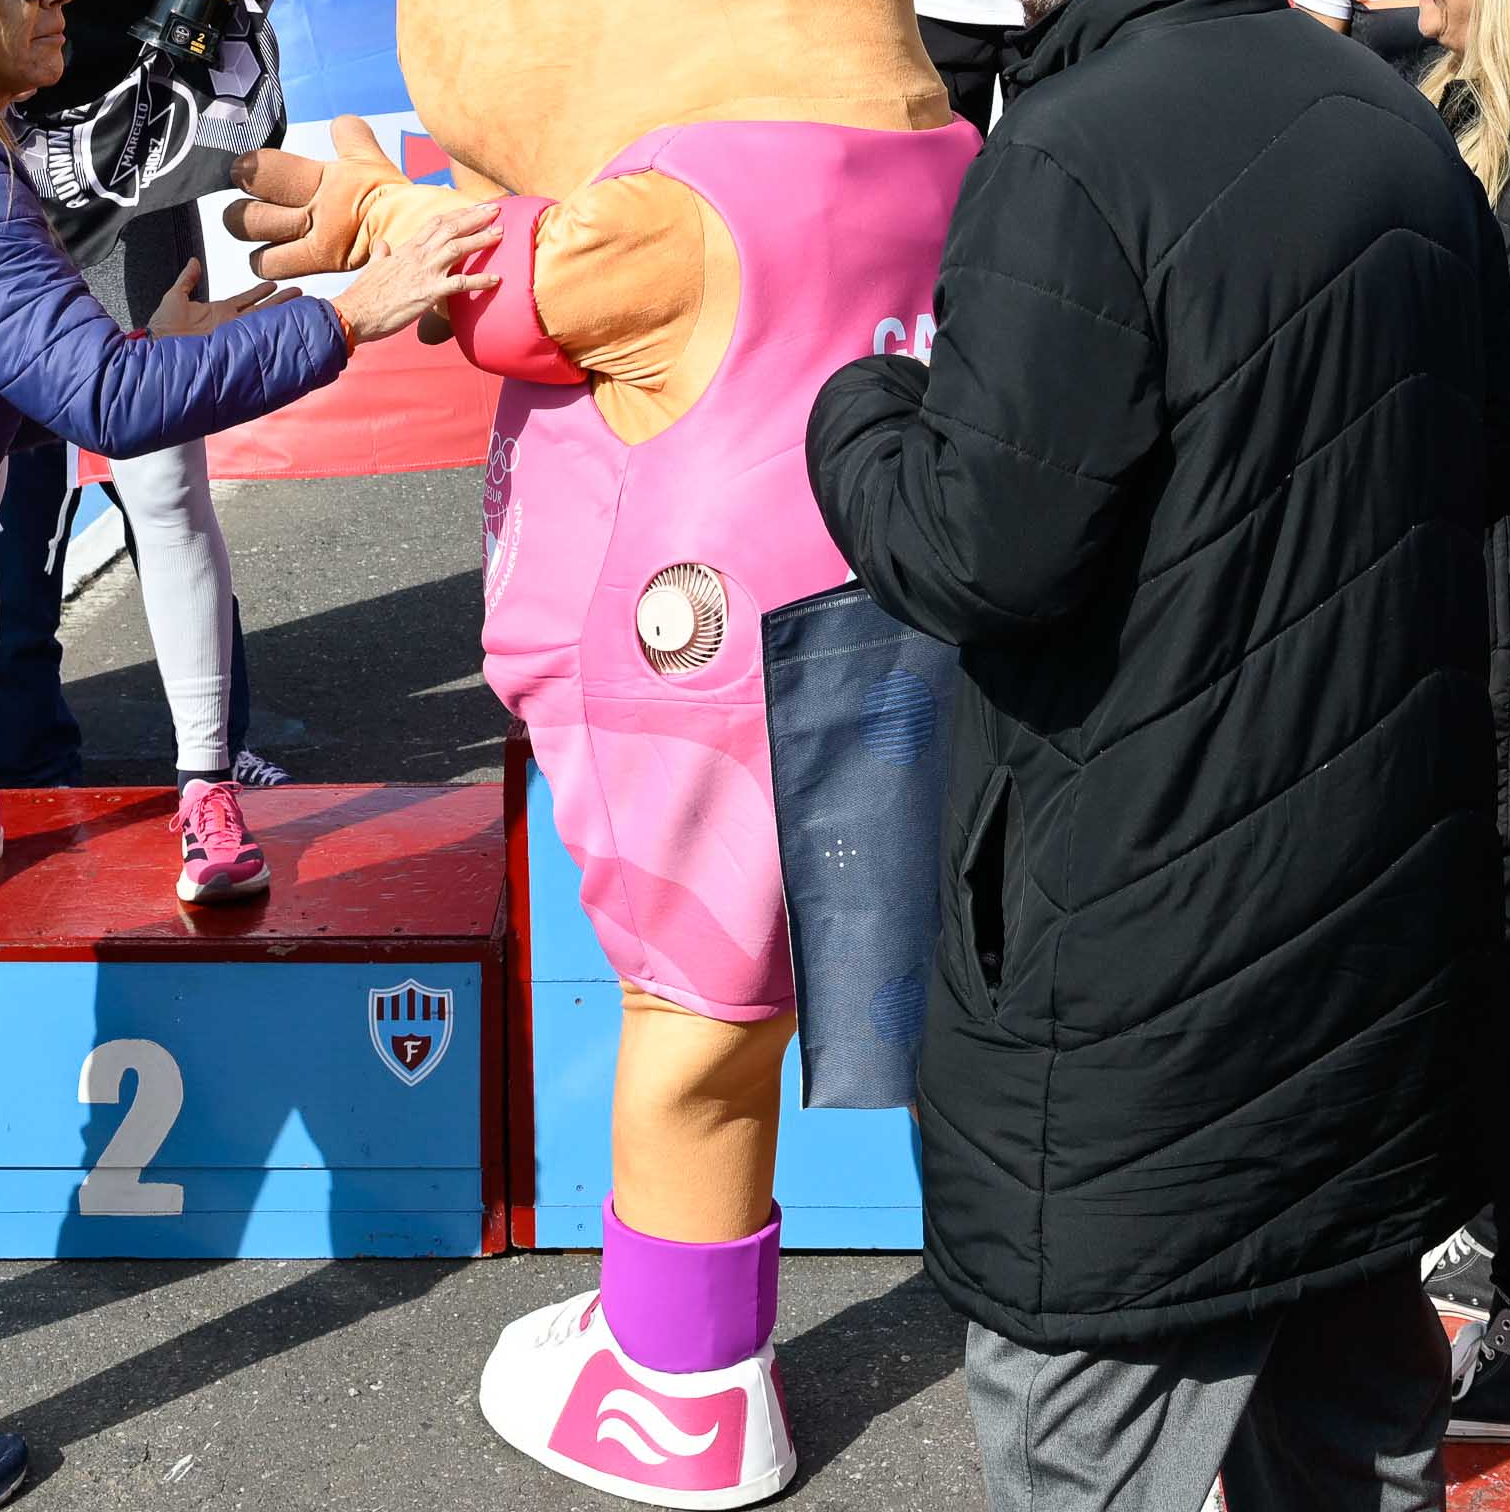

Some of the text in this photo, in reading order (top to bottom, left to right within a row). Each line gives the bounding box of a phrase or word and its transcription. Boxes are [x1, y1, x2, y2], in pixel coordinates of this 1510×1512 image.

[197, 33, 205, 42] 2
[121, 103, 149, 168] MARCELO
[404, 1040, 422, 1063] F
[78, 1039, 183, 1216] 2
